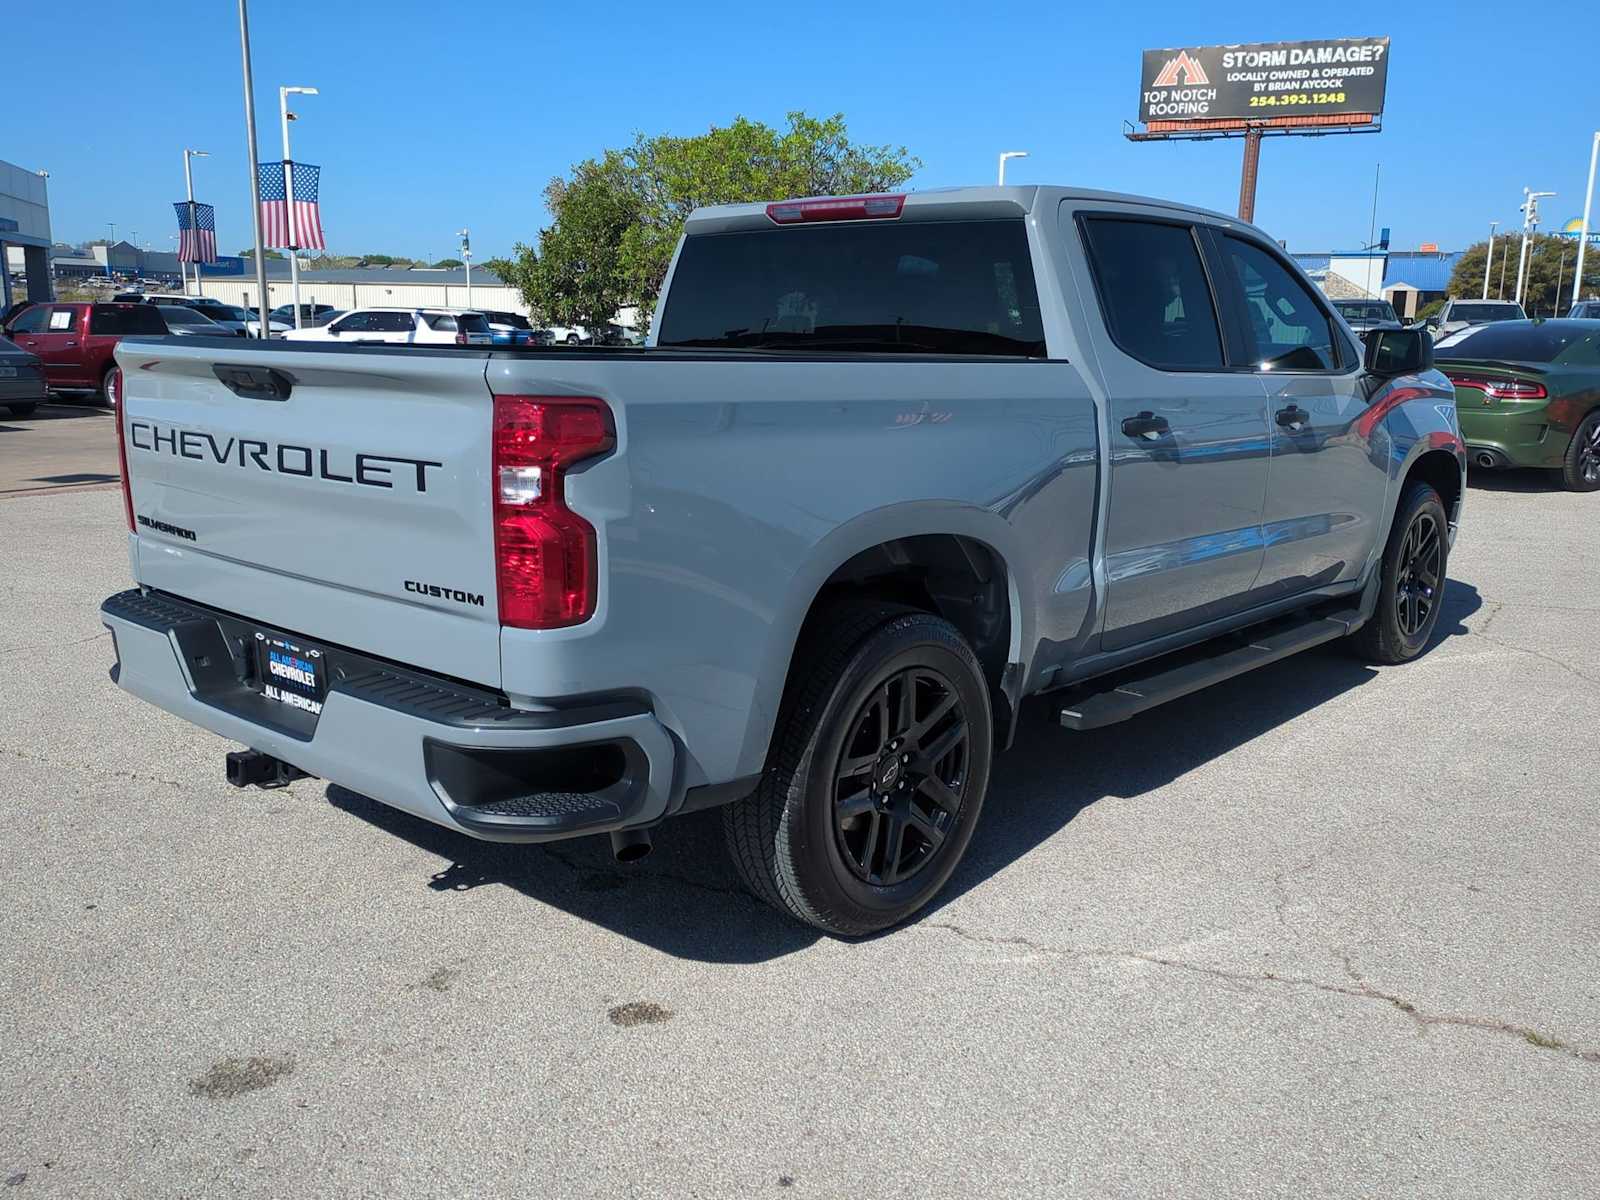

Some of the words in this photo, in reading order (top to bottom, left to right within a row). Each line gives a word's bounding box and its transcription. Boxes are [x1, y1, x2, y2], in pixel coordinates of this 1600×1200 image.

[1222, 50, 1287, 68] STORM
[1290, 45, 1384, 65] DAMAGE?
[1227, 72, 1268, 82] LOCALLY
[1269, 69, 1310, 80] OWNED
[1311, 68, 1320, 78] &
[1322, 66, 1374, 77] OPERATED
[1253, 82, 1266, 92] BY
[1268, 80, 1300, 91] BRIAN
[1301, 79, 1343, 89] AYCOCK
[1144, 90, 1168, 104] TOP
[1171, 88, 1216, 102] NOTCH
[1249, 93, 1345, 107] 254.393.1248
[1149, 101, 1209, 116] ROOFING
[131, 422, 443, 493] CHEVROLET
[137, 515, 196, 541] SILVERADO
[404, 580, 485, 606] CUSTOM
[270, 651, 281, 663] ALL
[270, 660, 316, 687] CHEVROLET
[265, 684, 280, 700] ALL
